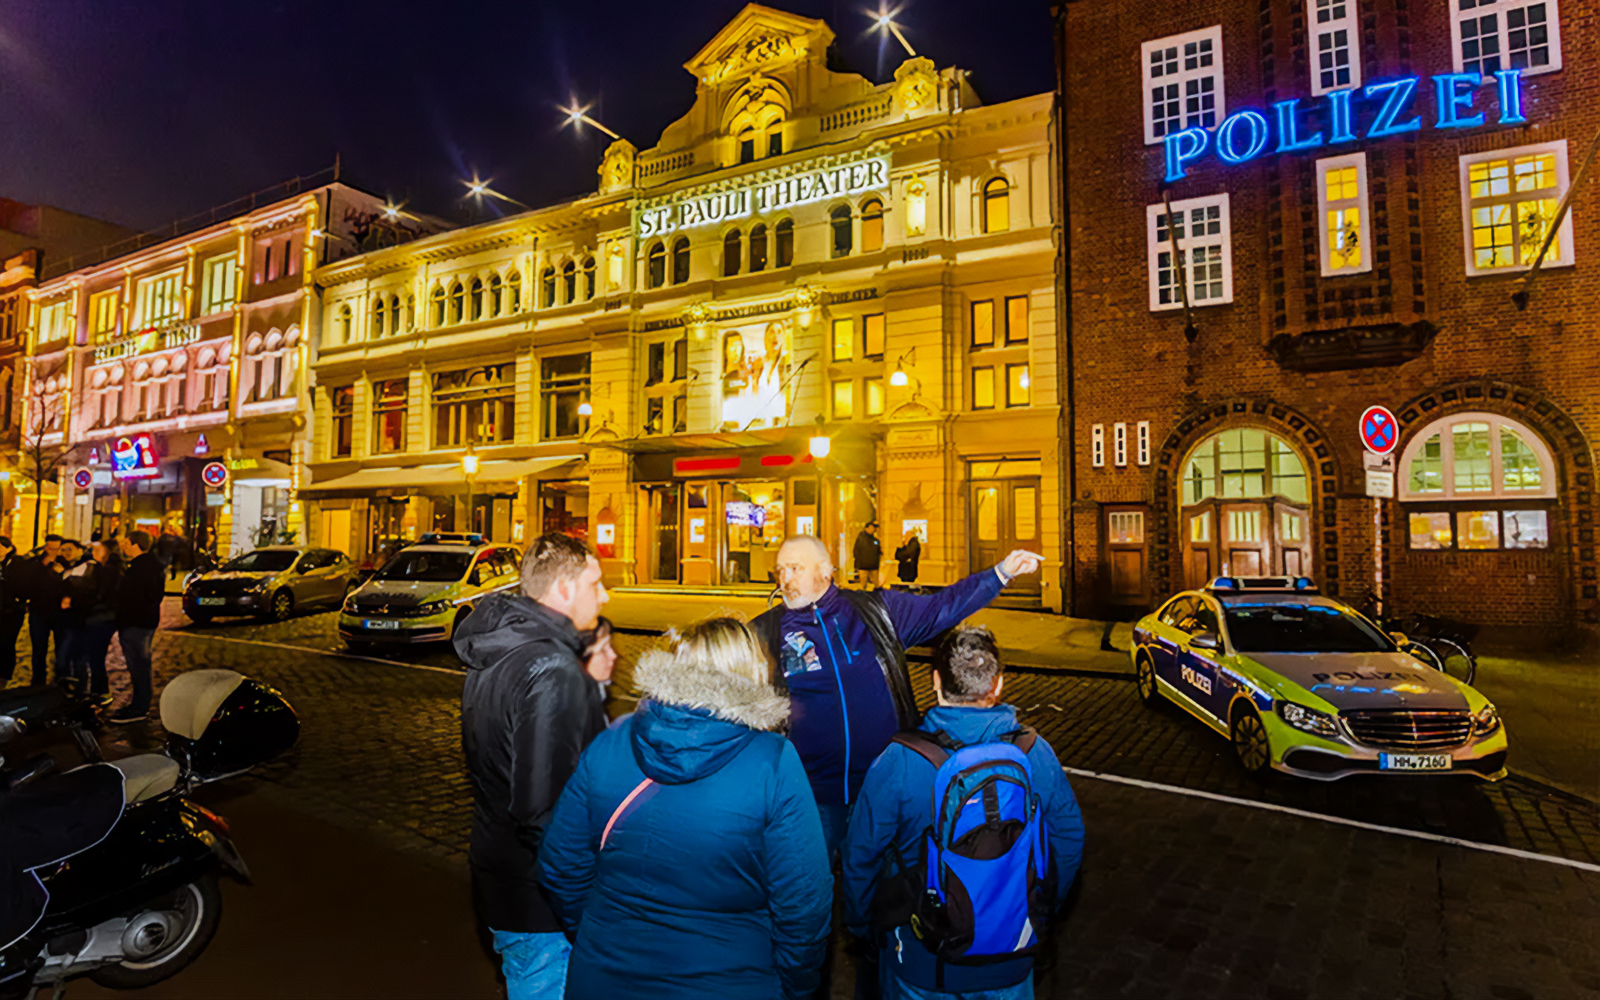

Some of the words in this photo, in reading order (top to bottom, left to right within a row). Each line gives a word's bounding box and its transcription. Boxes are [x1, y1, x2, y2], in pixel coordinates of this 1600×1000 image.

[1164, 69, 1526, 183] POLIZEI
[640, 208, 672, 234] ST.
[680, 190, 747, 226] PAULI
[759, 160, 884, 209] THEATER
[1181, 664, 1212, 696] POLIZEI
[1312, 671, 1428, 683] POLIZEI
